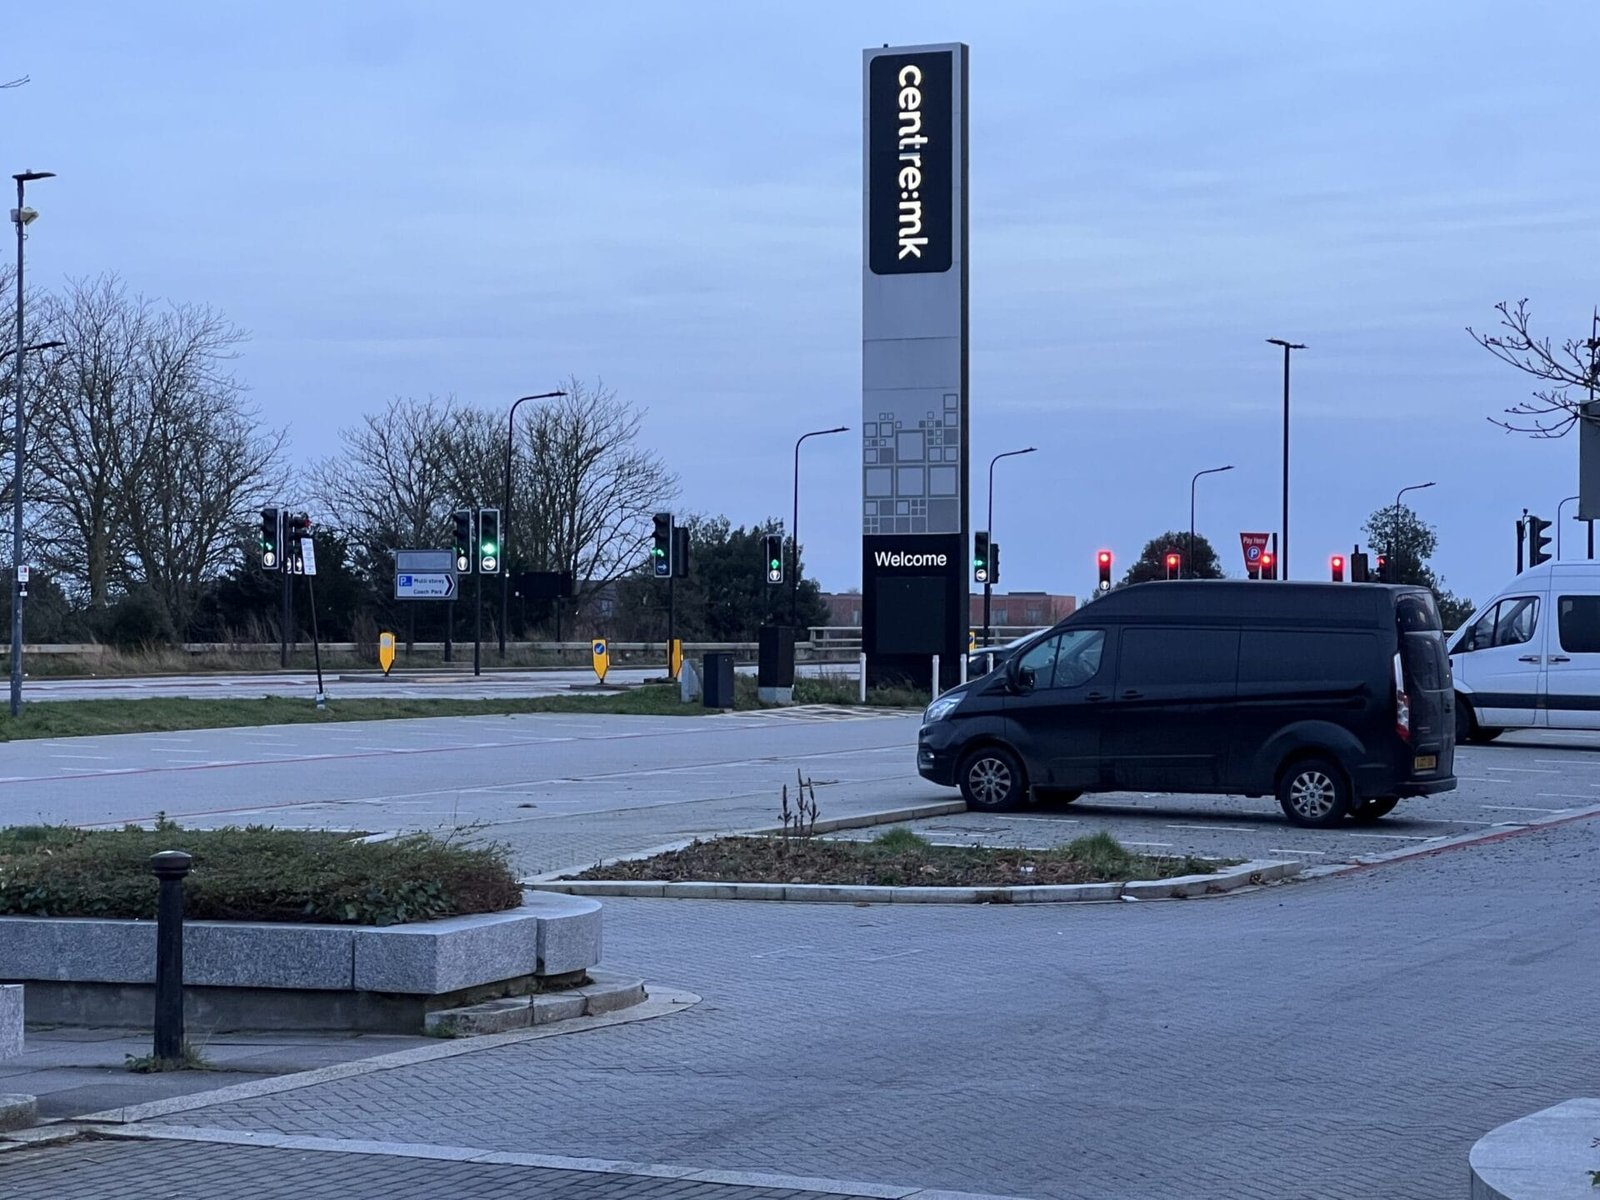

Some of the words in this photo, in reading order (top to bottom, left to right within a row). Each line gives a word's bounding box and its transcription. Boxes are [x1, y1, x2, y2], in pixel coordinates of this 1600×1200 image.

[898, 65, 928, 259] centre:mk
[1243, 536, 1253, 545] Pay
[874, 551, 947, 567] Welcome
